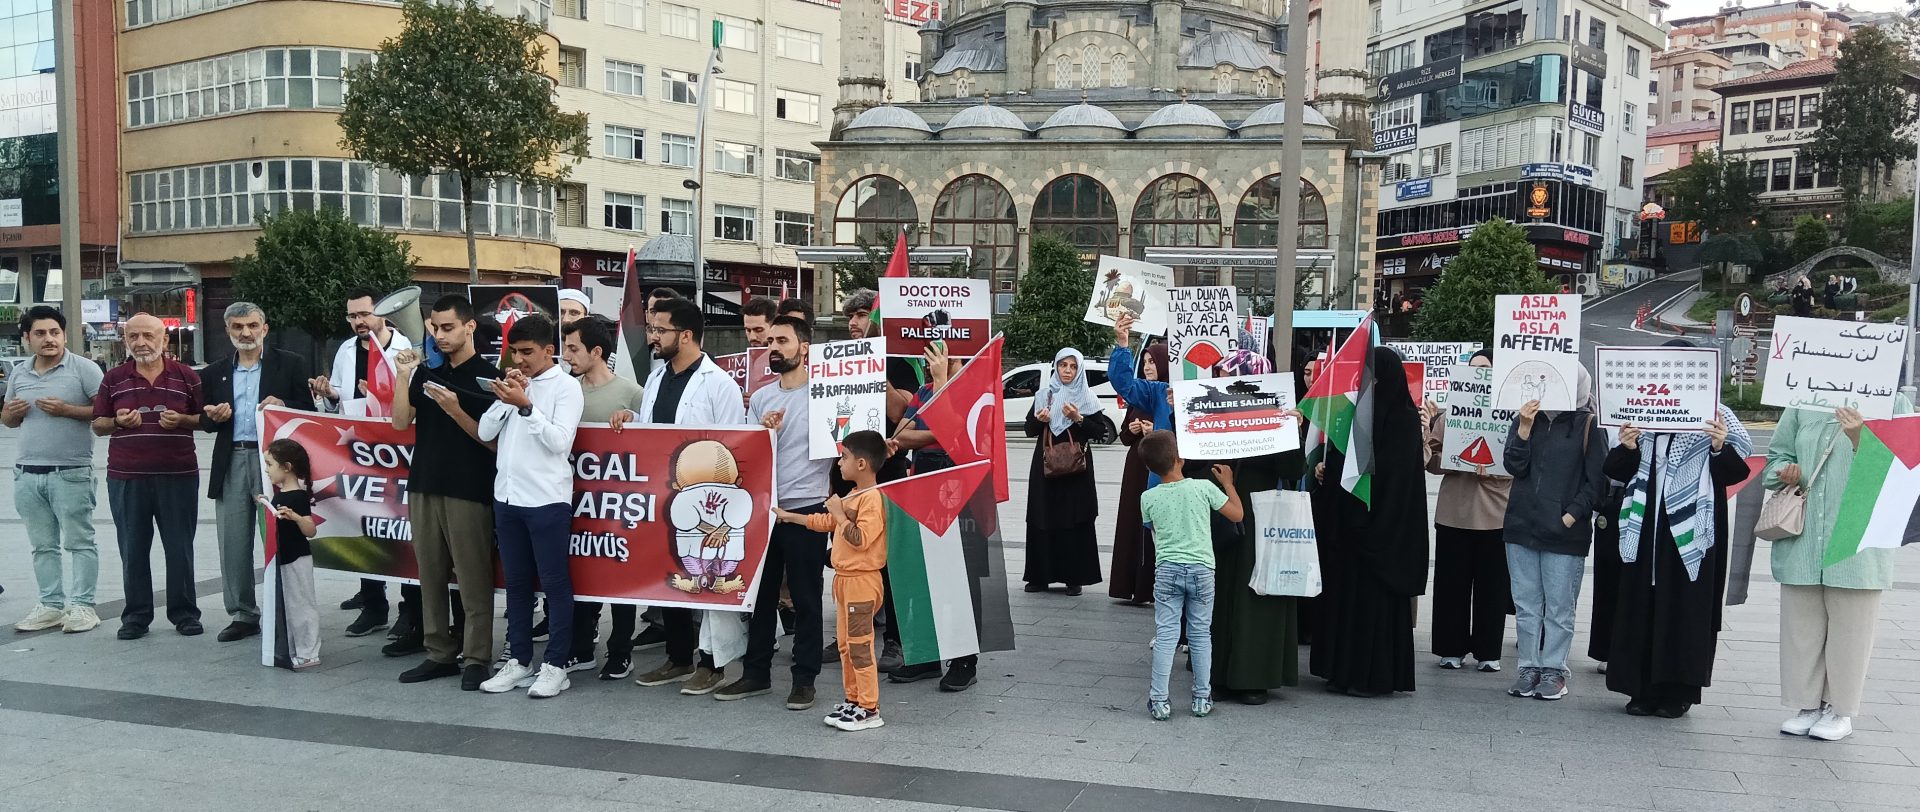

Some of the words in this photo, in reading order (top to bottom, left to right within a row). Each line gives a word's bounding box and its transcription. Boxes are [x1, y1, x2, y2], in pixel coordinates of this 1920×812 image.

[884, 0, 939, 21] EZİ
[1573, 103, 1603, 123] GÜVEN
[1375, 127, 1415, 144] GÜVEN
[899, 285, 971, 298] DOCTORS
[907, 299, 937, 308] STAND
[939, 300, 963, 308] WITH
[1168, 301, 1188, 313] LAL
[1520, 295, 1559, 309] ASLA
[1199, 312, 1229, 324] ASLA
[1512, 310, 1567, 321] UNUTMA
[901, 327, 970, 339] PALESTINE
[1519, 322, 1560, 336] ASLA
[1886, 328, 1904, 344] لن
[823, 341, 874, 361] ÖZGÜR
[1855, 345, 1878, 362] لن
[811, 356, 885, 379] FİLİSTİN
[1786, 372, 1798, 390] يا
[1637, 383, 1671, 396] +24
[1194, 400, 1239, 410] SİVİLLERE
[1240, 397, 1276, 407] SALDIRI
[1626, 397, 1681, 407] HASTANE
[1451, 404, 1483, 418] DAHA
[1491, 409, 1516, 421] ÇOK
[1610, 412, 1636, 421] HİZMET
[1193, 420, 1227, 430] SAVAŞ
[342, 474, 388, 503] VE
[1264, 528, 1277, 538] LC
